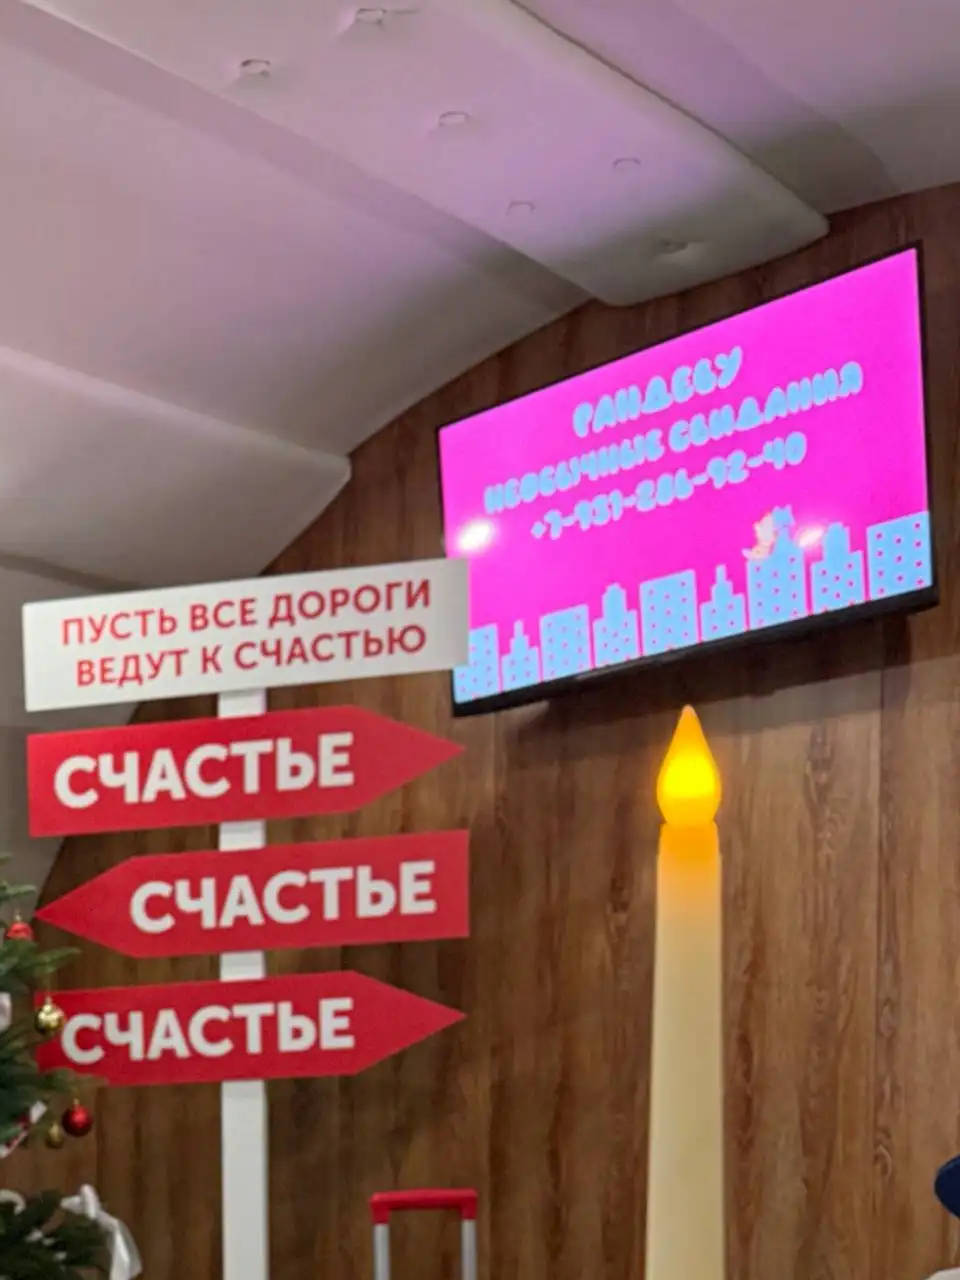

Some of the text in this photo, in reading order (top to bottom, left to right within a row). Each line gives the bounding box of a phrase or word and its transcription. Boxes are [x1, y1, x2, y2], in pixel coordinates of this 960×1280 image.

[572, 345, 742, 438] РАНДЕВУ
[61, 578, 431, 645] ПУСТЬ ВСЕ ДОРОГИ
[76, 624, 426, 688] ВЕДУТ К СЧАСТЬЮ
[54, 732, 354, 809] СЧАСТЬЕ
[130, 860, 436, 934] СЧАСТЬЕ
[61, 997, 354, 1064] СЧАСТЬЕ
